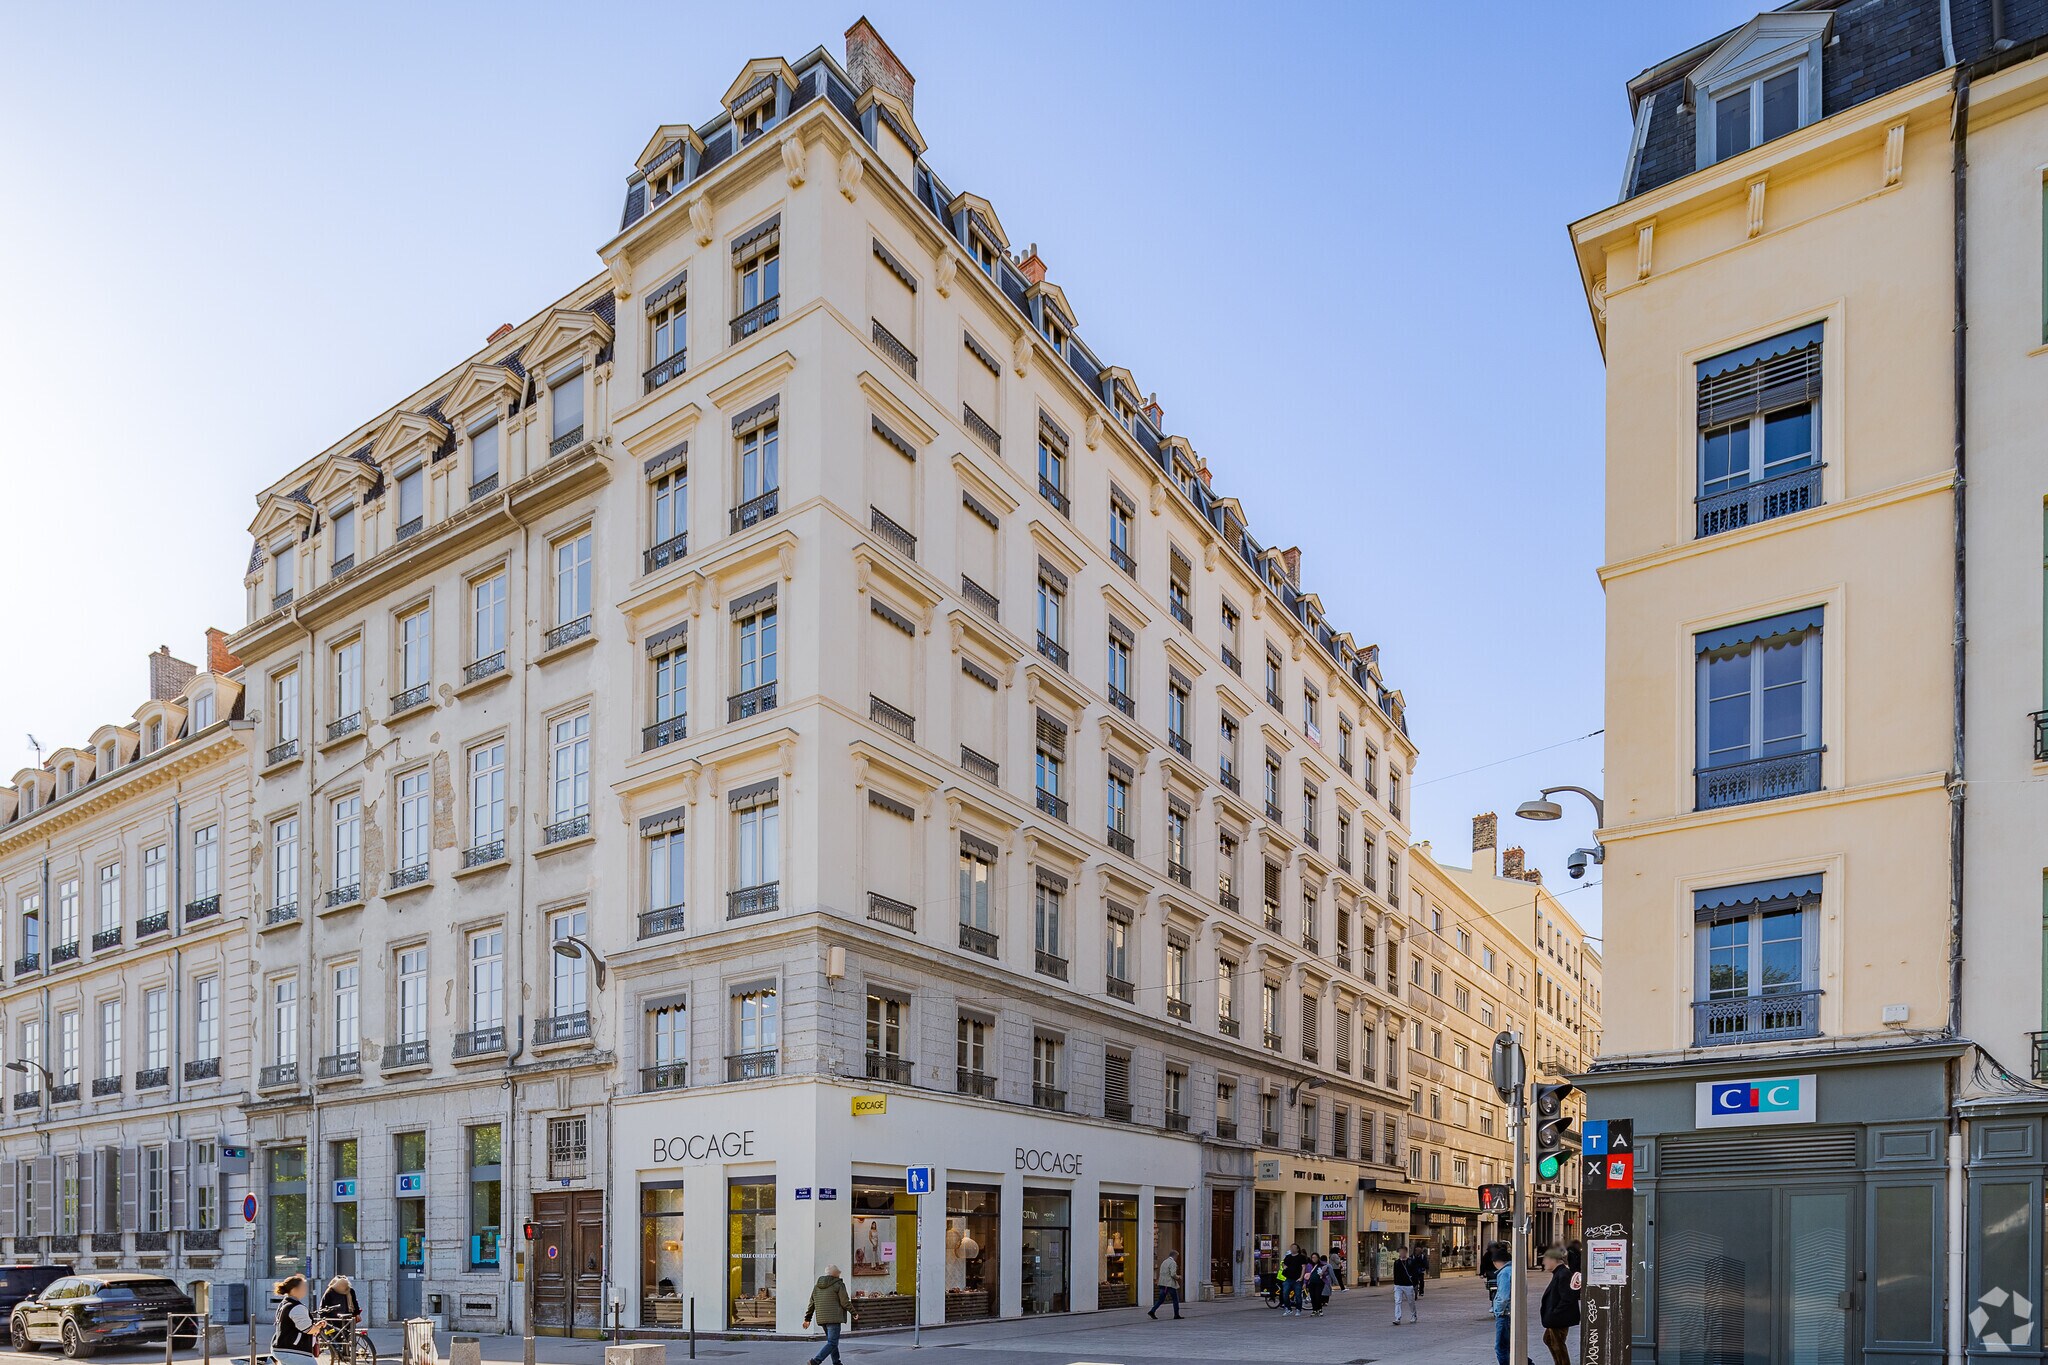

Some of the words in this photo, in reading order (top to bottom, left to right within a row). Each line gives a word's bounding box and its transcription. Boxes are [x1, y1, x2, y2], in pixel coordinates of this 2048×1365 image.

[855, 1100, 884, 1110] BOCAGE
[1719, 1086, 1790, 1109] CIC
[653, 1130, 754, 1163] BOCAGE
[1015, 1147, 1083, 1175] BOCAGE
[338, 1184, 353, 1194] CIC
[402, 1178, 419, 1188] CIC
